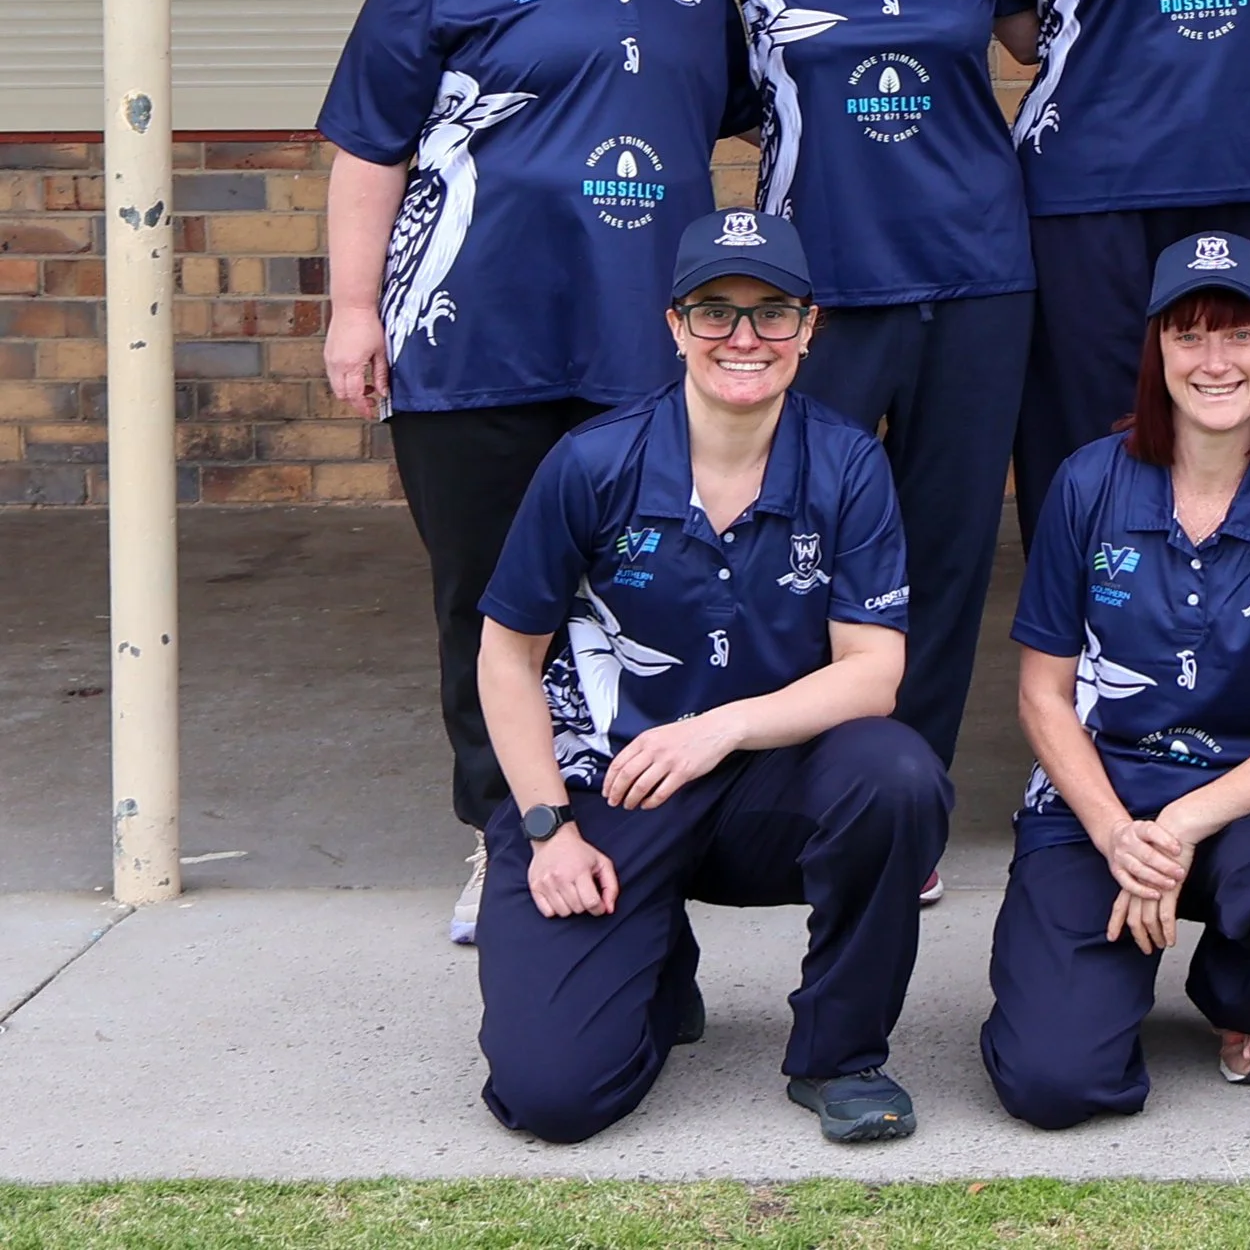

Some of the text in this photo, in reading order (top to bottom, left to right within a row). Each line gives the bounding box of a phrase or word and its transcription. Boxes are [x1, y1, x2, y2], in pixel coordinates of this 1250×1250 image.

[1170, 11, 1195, 21] 0432
[1198, 9, 1216, 19] 671
[1177, 21, 1235, 40] TREE CARE
[848, 53, 930, 86] HEDGE TRIMMING
[847, 96, 932, 114] RUSSELL'S
[857, 112, 882, 122] 0432
[884, 111, 901, 121] 671
[863, 125, 920, 143] TREE CARE
[585, 136, 663, 172] HEDGE TRIMMING
[582, 180, 666, 200] RUSSELL'S
[592, 197, 617, 206] 0432
[620, 198, 637, 207] 671
[598, 210, 653, 230] TREE CARE
[1091, 585, 1131, 601] SOUTHERN
